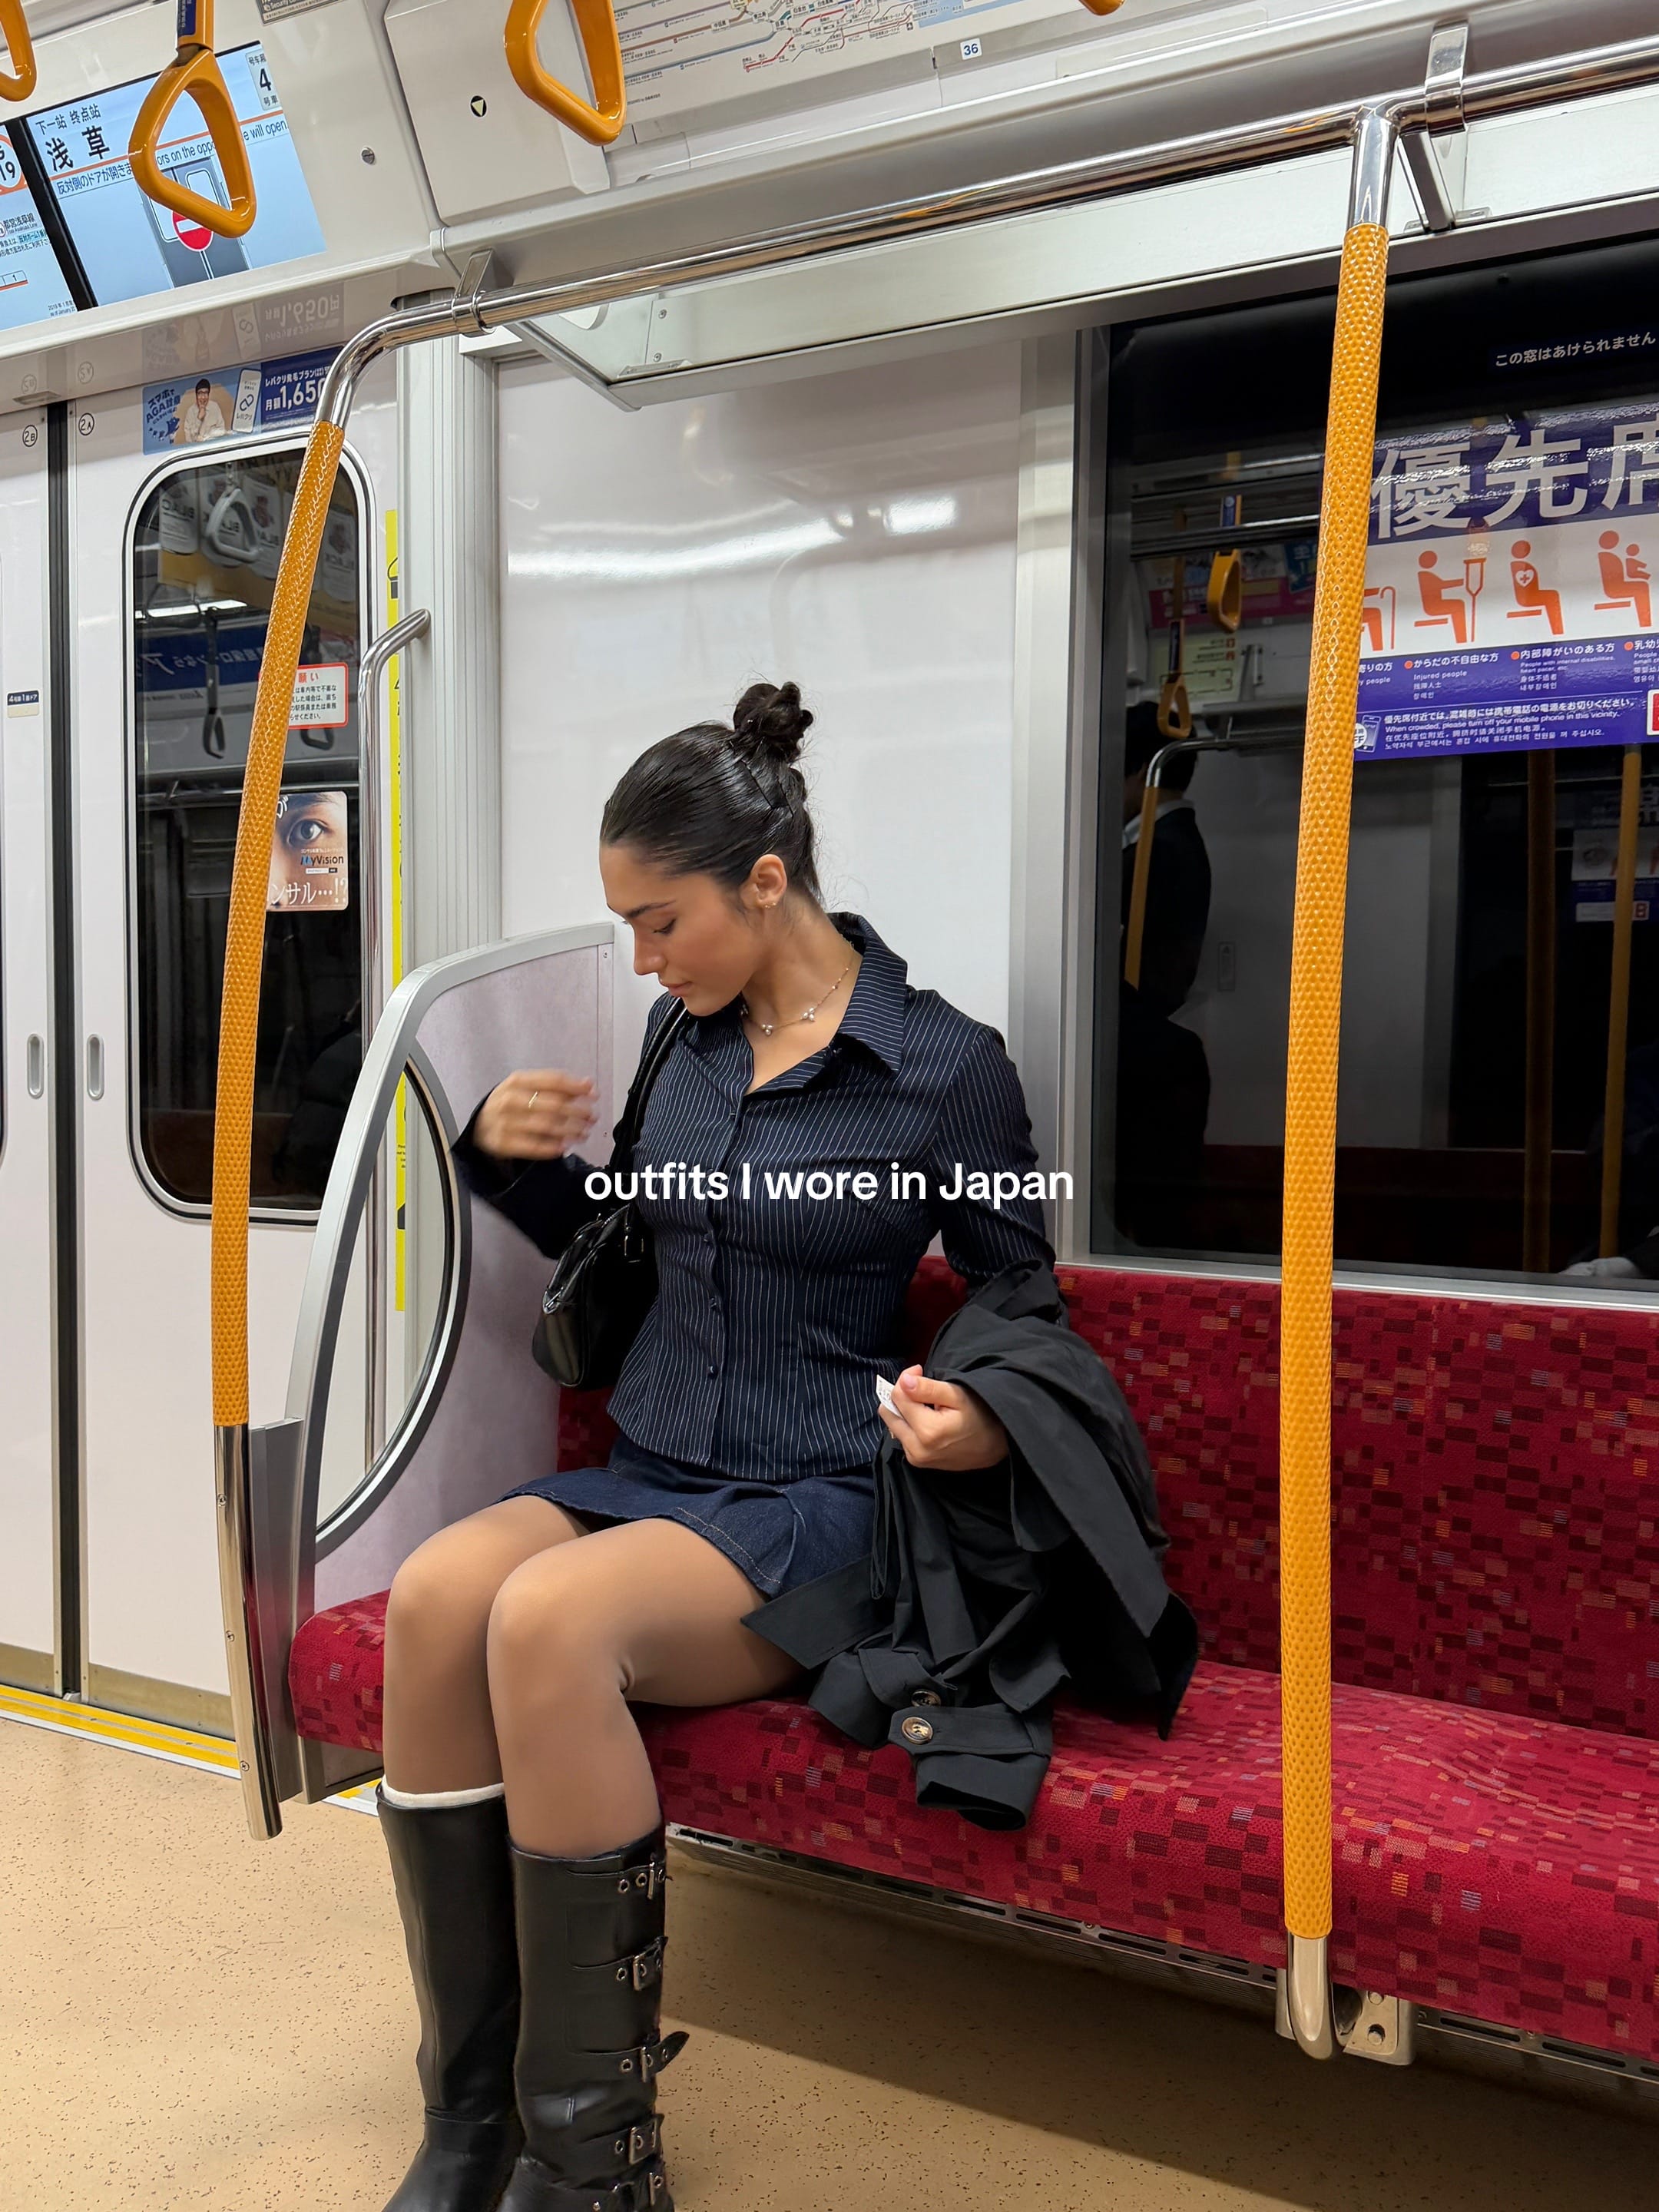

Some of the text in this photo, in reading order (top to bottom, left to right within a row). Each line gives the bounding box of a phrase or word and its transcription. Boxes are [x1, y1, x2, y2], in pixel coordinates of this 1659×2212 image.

[964, 44, 979, 55] 36
[259, 68, 271, 91] 4
[35, 114, 67, 135] 下一站
[250, 124, 263, 139] will
[171, 150, 181, 161] on
[181, 146, 197, 158] the
[1495, 331, 1656, 366] この窓はあけられません
[80, 419, 91, 431] 2A
[25, 431, 35, 442] 2B
[1520, 643, 1615, 660] 内部障がいのある方
[1413, 653, 1498, 667] からだの不自由な方
[1366, 677, 1391, 686] people
[1413, 670, 1467, 680] Injured people
[1385, 725, 1406, 733] When
[1442, 720, 1467, 730] please
[1468, 719, 1482, 727] turn
[1495, 717, 1512, 727] your
[1541, 714, 1565, 723] phone
[300, 855, 343, 866] MyVision
